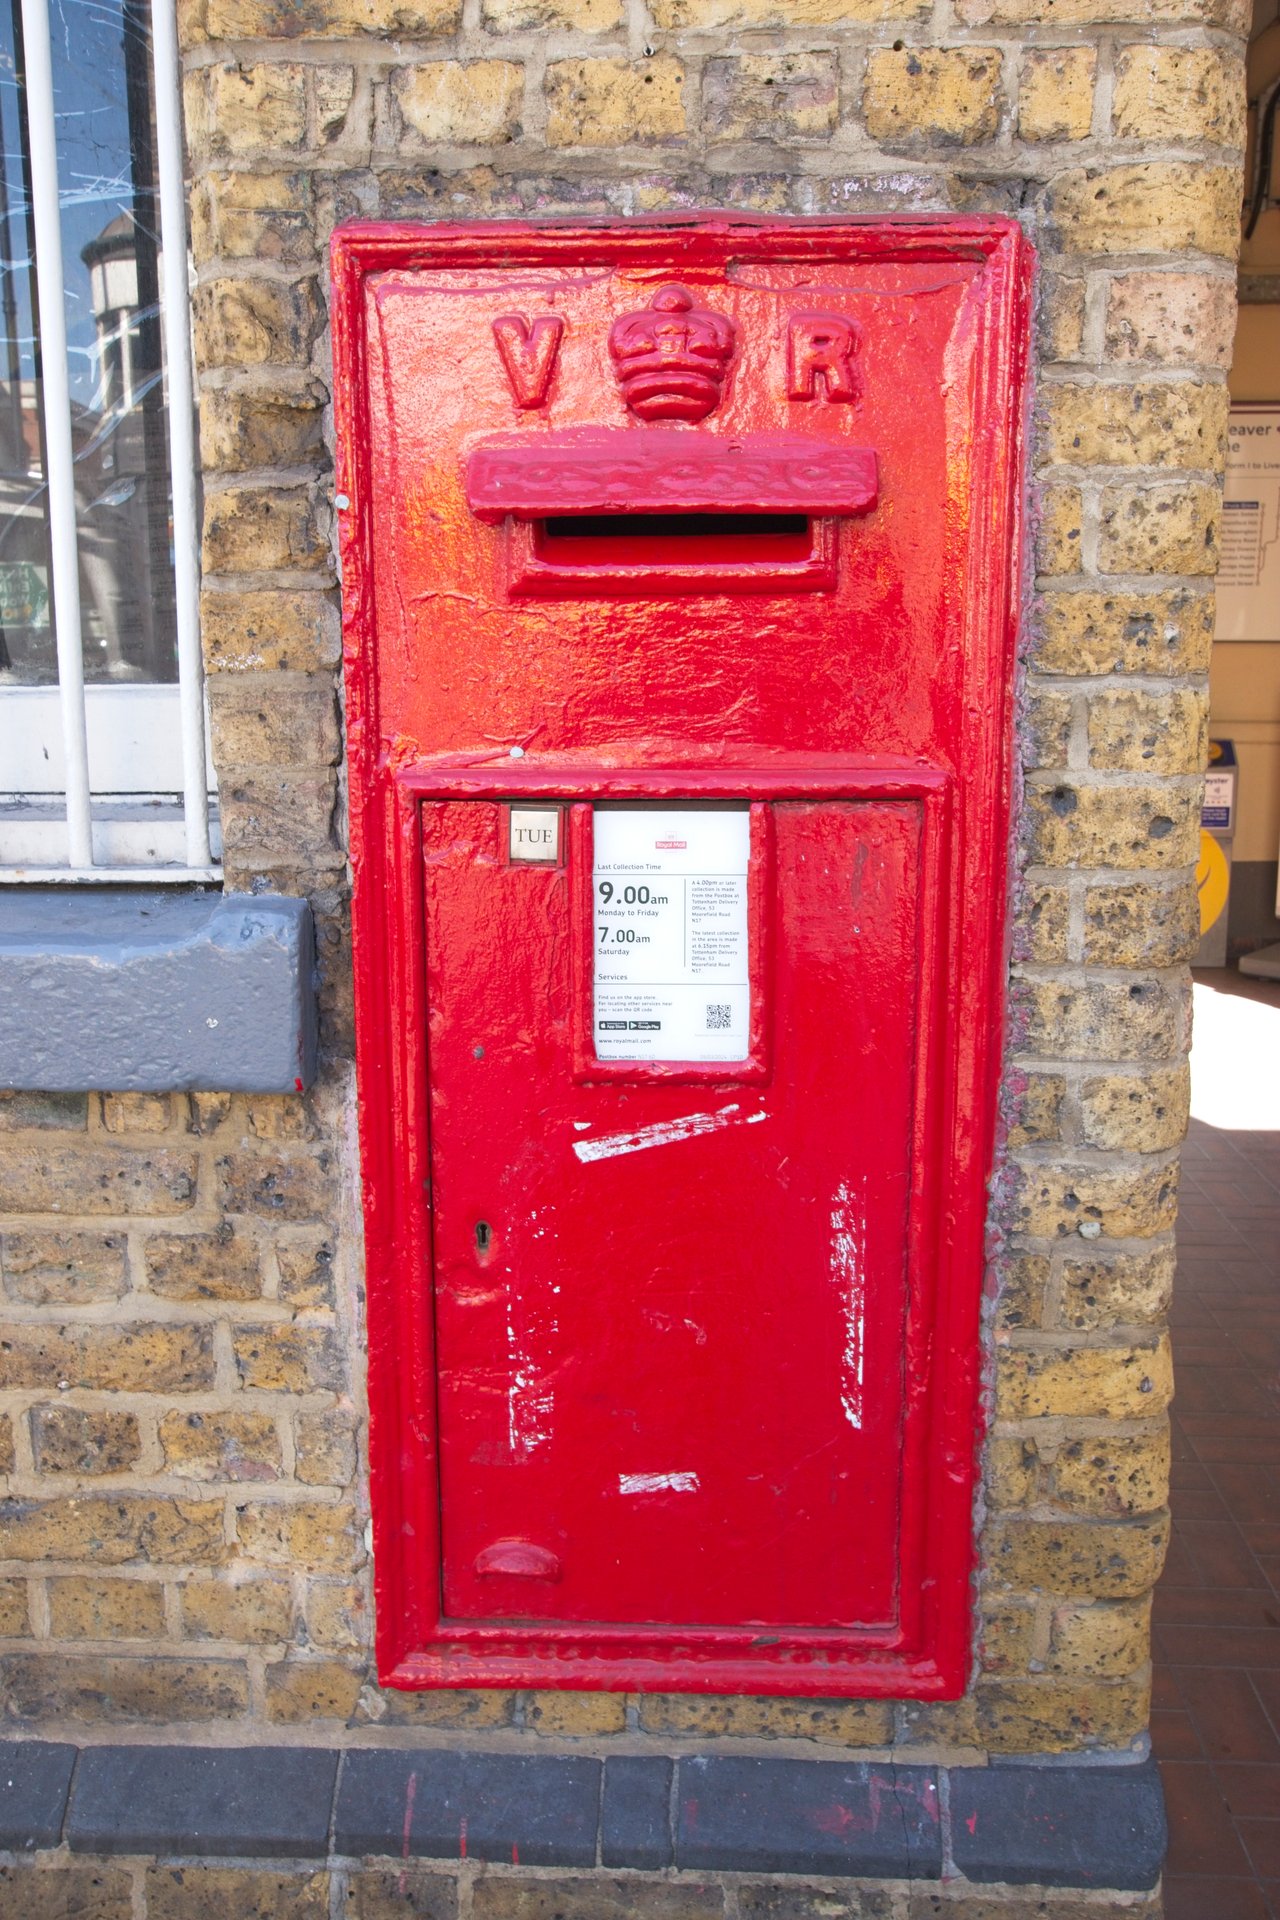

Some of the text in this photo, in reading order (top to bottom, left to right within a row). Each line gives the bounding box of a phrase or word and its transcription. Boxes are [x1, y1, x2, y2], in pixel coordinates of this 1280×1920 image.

[493, 312, 861, 409] V R
[1229, 426, 1272, 436] eaver
[515, 828, 552, 843] TUE
[598, 881, 668, 905] 9.00am
[598, 926, 650, 943] 7.00am
